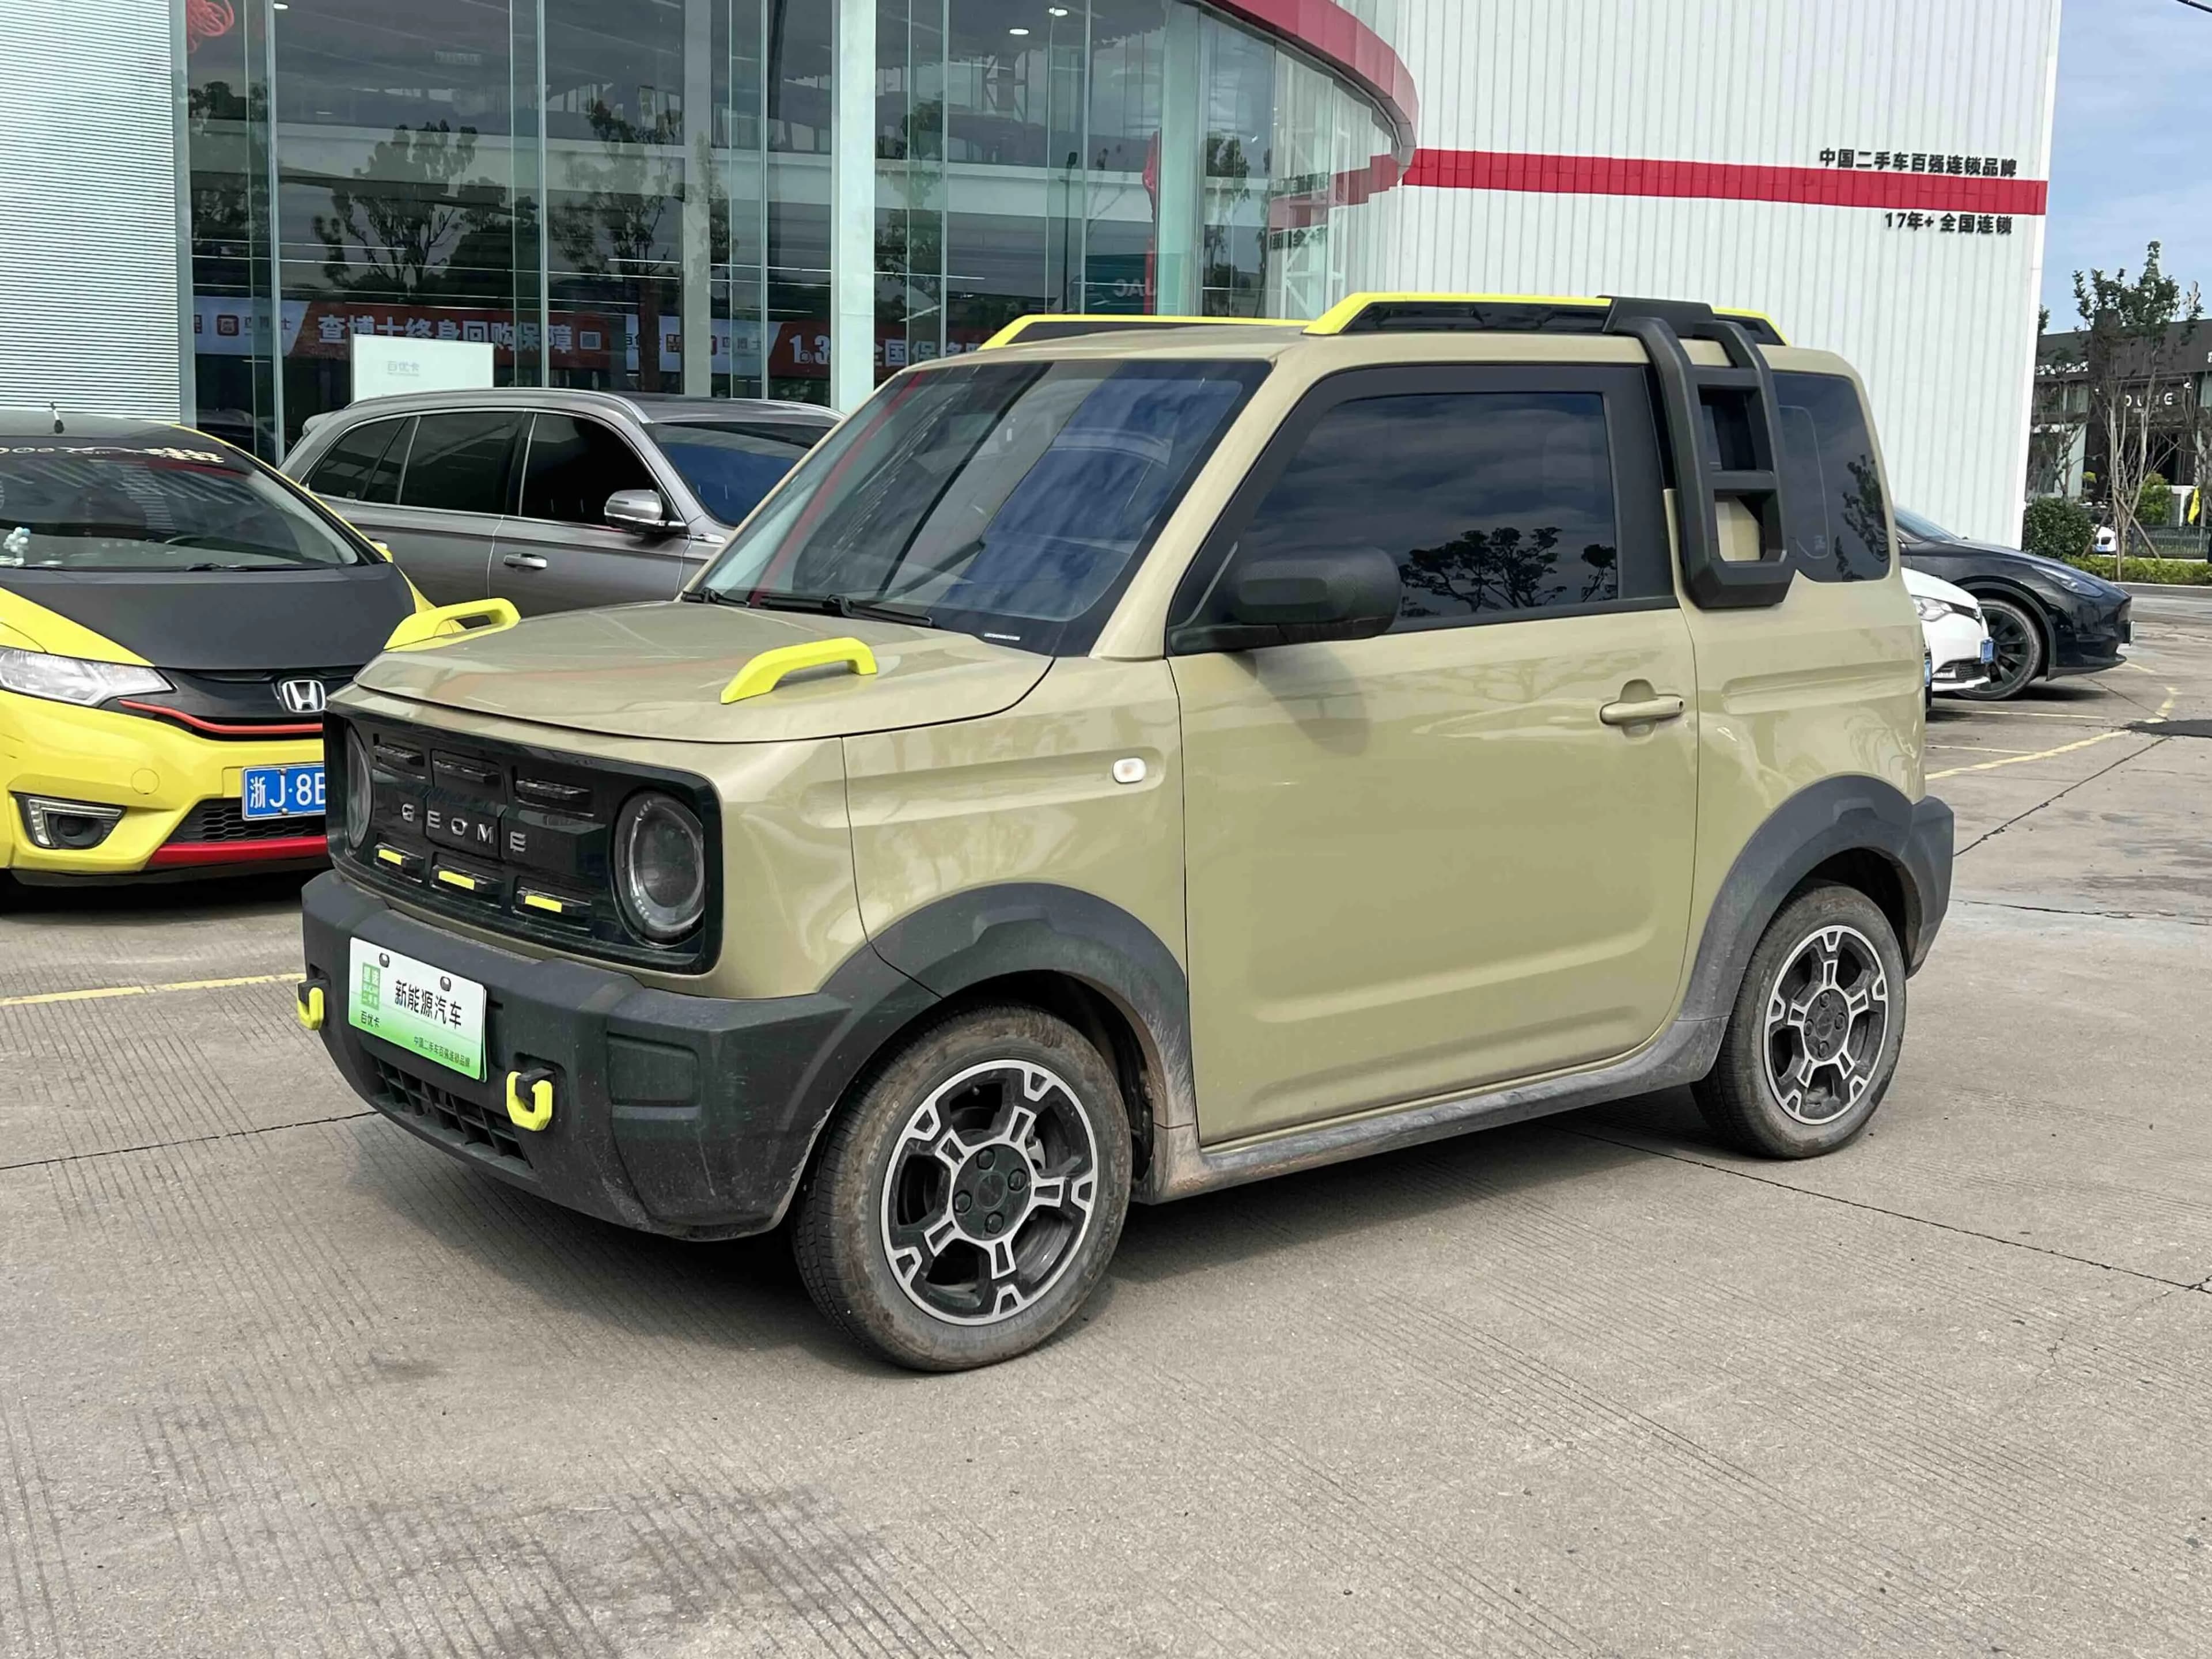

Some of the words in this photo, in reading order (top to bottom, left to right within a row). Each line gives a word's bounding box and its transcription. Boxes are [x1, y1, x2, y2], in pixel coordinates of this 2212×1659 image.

[1819, 147, 2017, 177] 中国二手车百强连锁品牌
[1885, 211, 1934, 232] 17年+
[1940, 213, 2012, 235] 全国连锁
[402, 802, 527, 853] GEOME
[361, 1010, 380, 1028] 百优卡
[395, 979, 463, 1029] 新能源汽车
